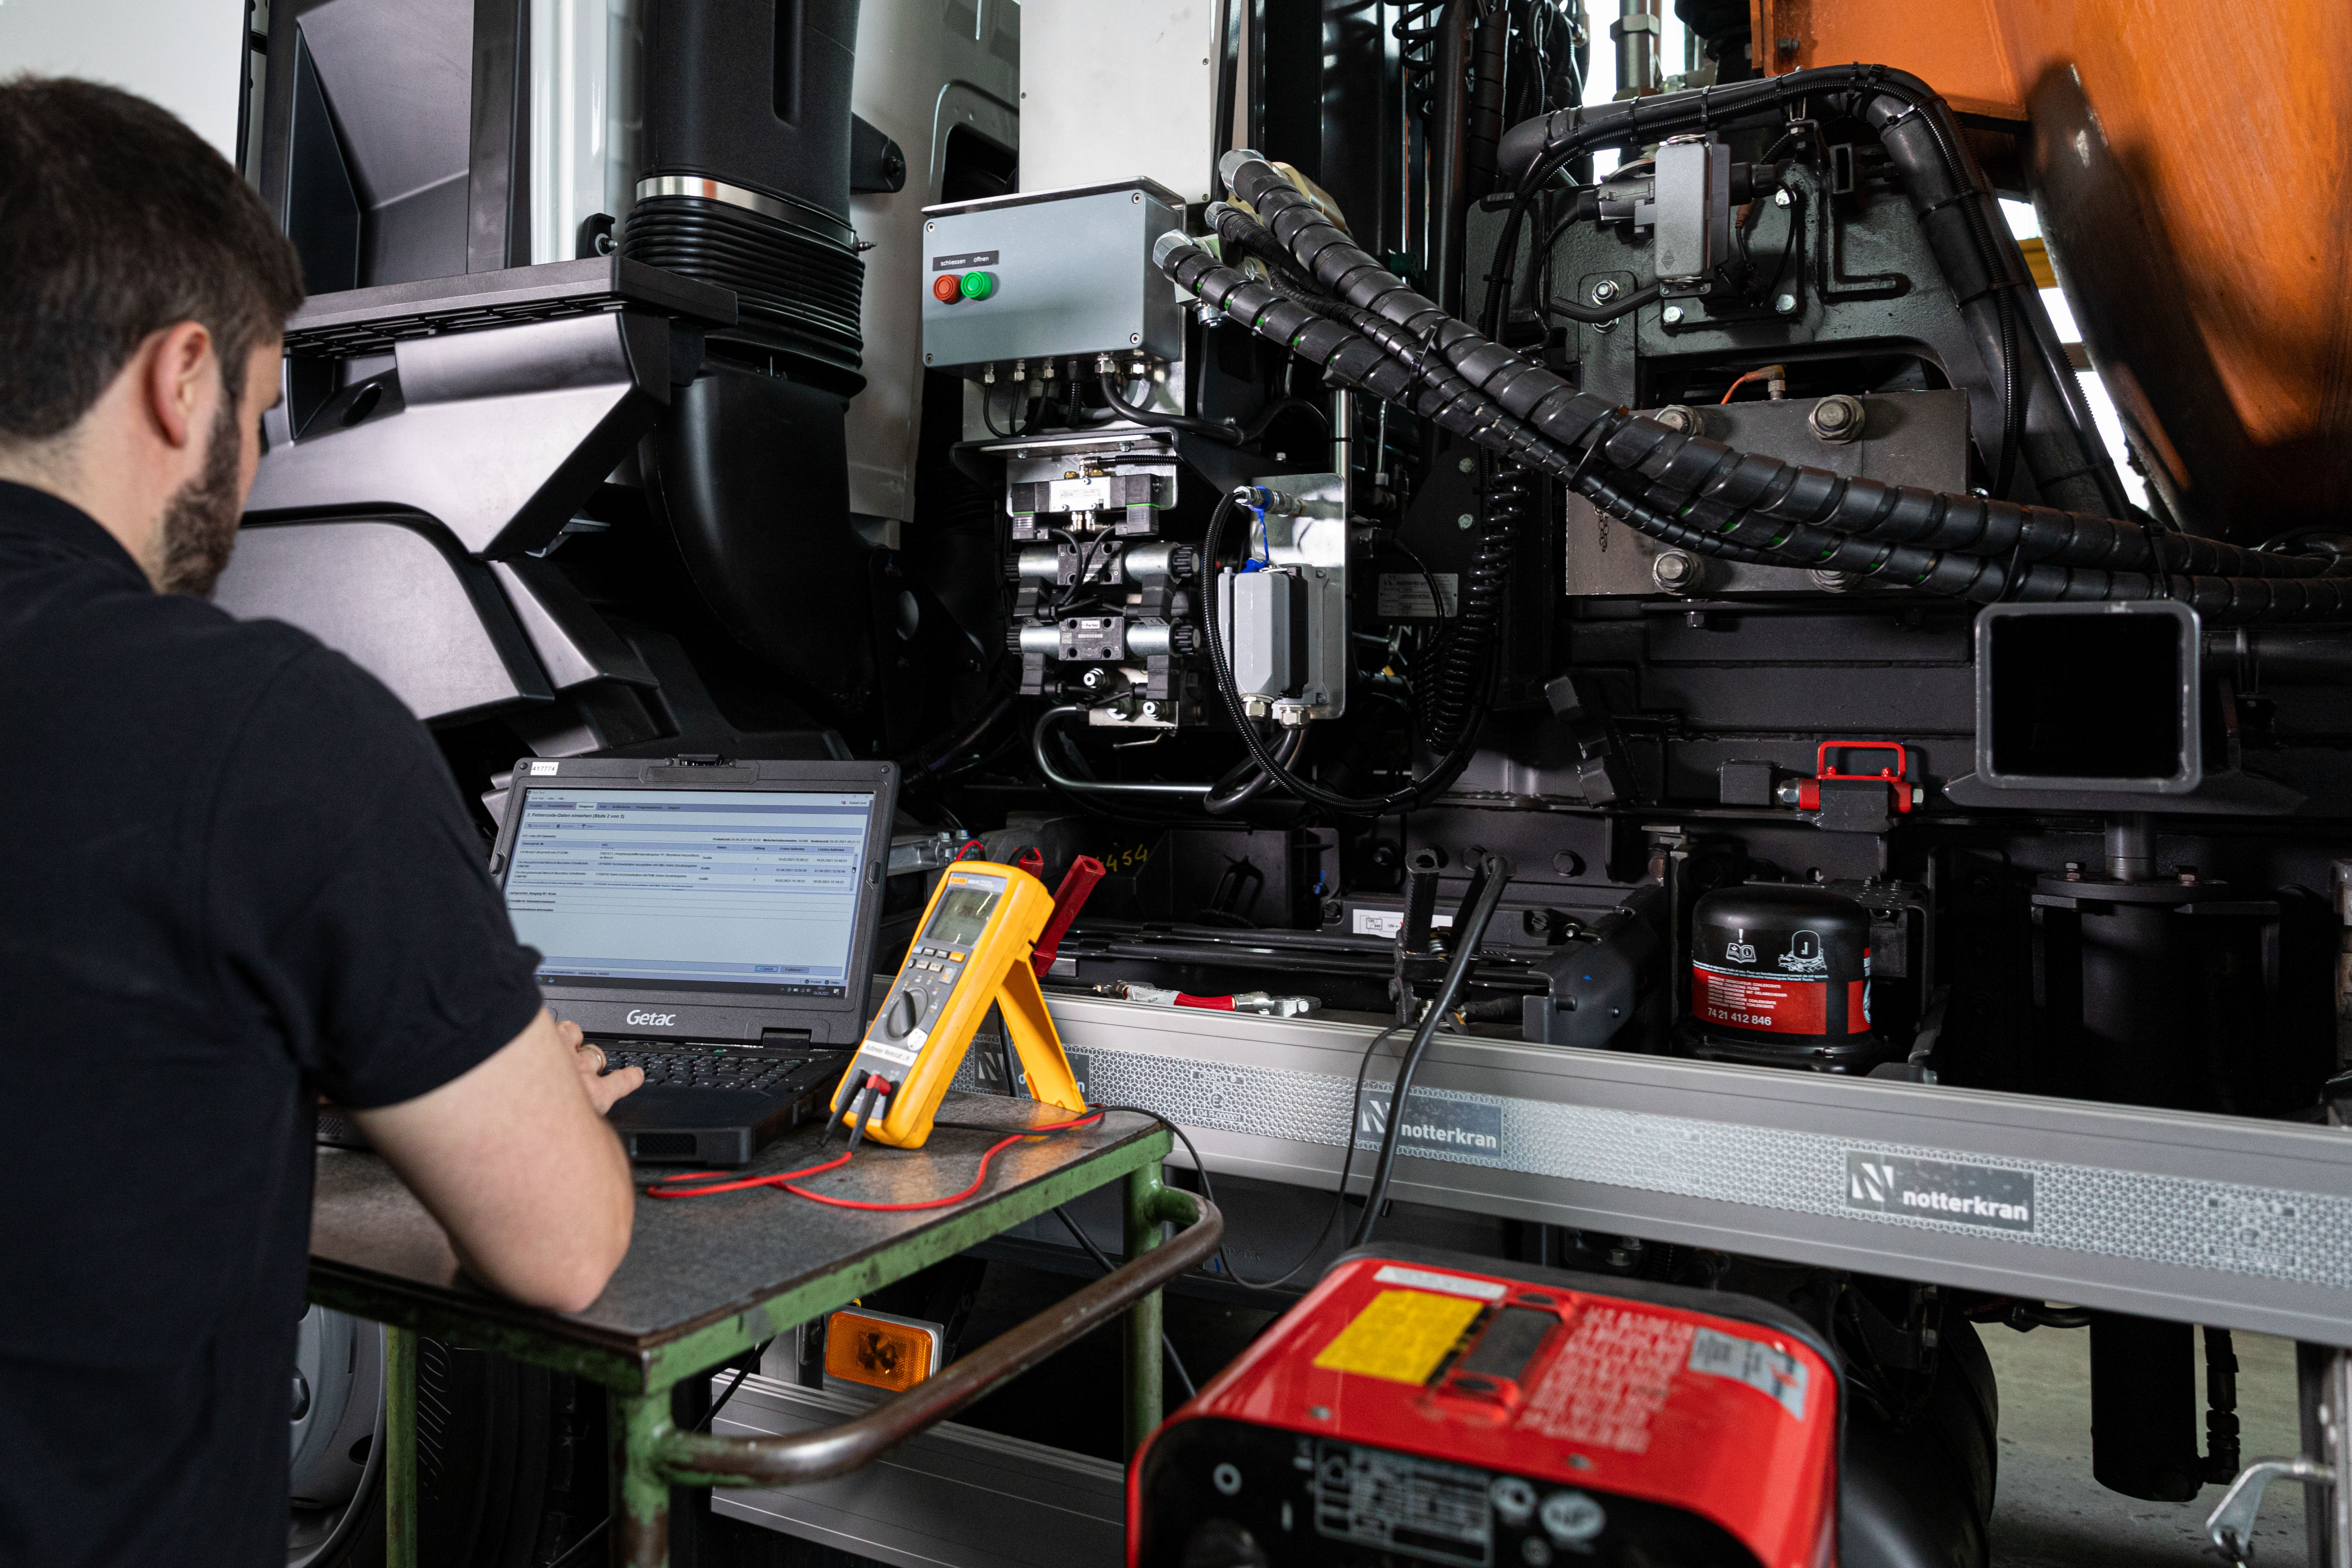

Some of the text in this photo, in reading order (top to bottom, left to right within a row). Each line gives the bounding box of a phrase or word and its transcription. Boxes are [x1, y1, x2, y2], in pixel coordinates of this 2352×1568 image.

[626, 1009, 676, 1026] Getac
[1708, 1008, 1772, 1026] 74 21 412 846
[1209, 1110, 1241, 1122] R-000001
[1401, 1123, 1497, 1148] notterkran
[1902, 1190, 2029, 1222] notterkran
